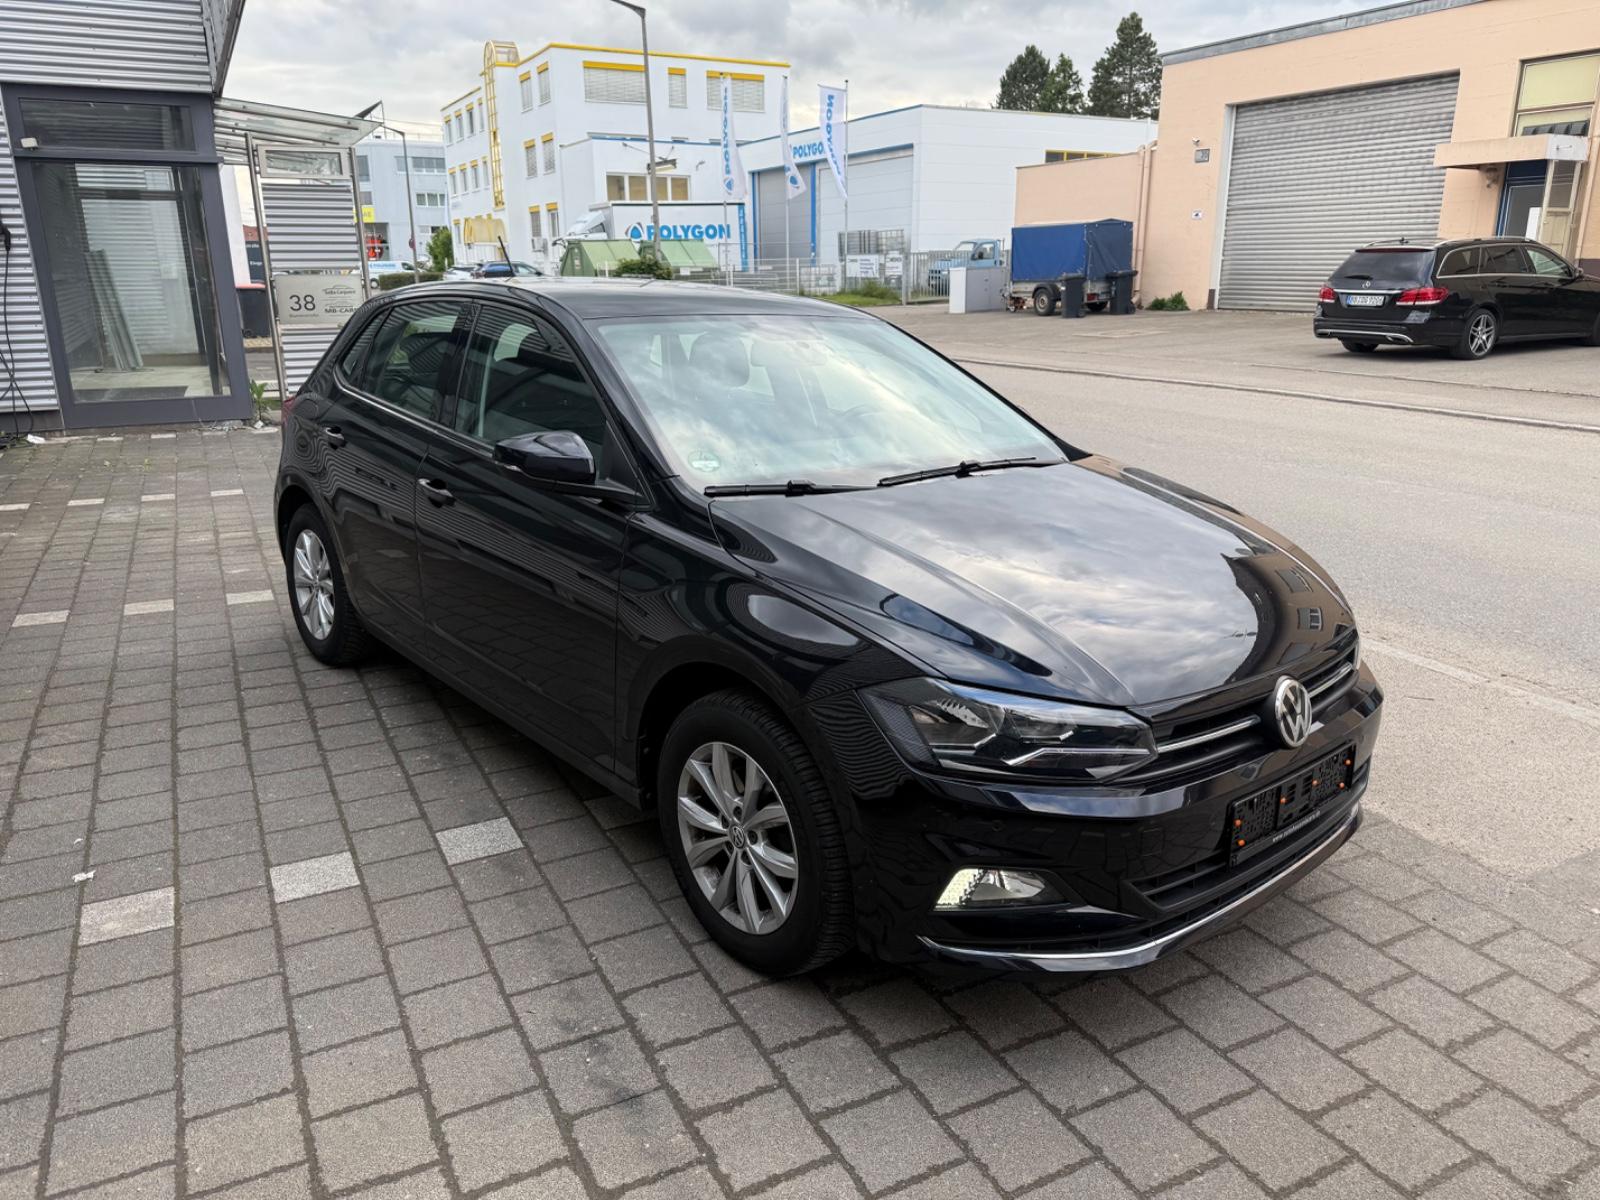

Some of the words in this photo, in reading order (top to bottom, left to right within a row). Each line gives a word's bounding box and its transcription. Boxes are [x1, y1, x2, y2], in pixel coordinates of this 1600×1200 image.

[792, 141, 825, 159] POLYGO
[646, 223, 731, 240] POLYGON
[289, 294, 316, 311] 38
